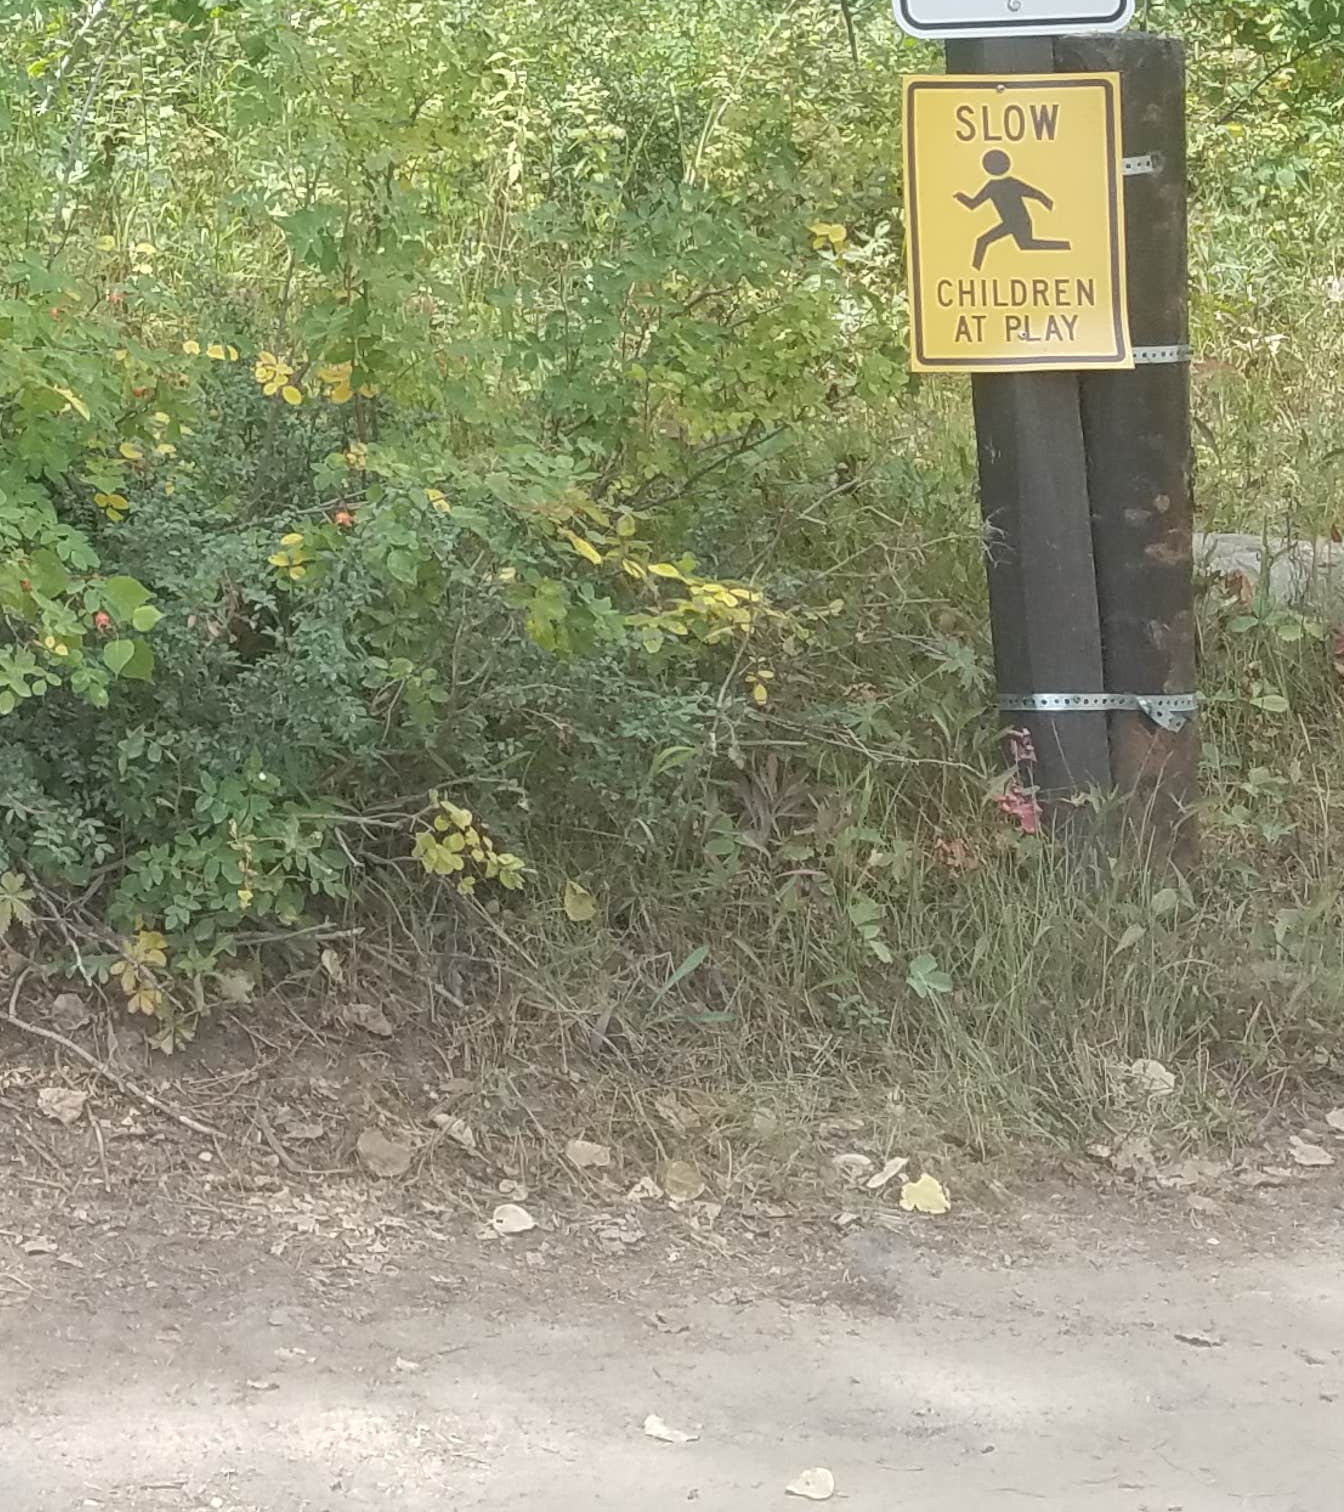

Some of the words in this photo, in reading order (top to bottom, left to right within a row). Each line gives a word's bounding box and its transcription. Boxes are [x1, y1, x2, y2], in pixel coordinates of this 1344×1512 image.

[955, 104, 1059, 142] SLOW
[937, 279, 1095, 307] CHILDREN
[955, 315, 986, 343] AT
[1005, 315, 1078, 342] PLAY
